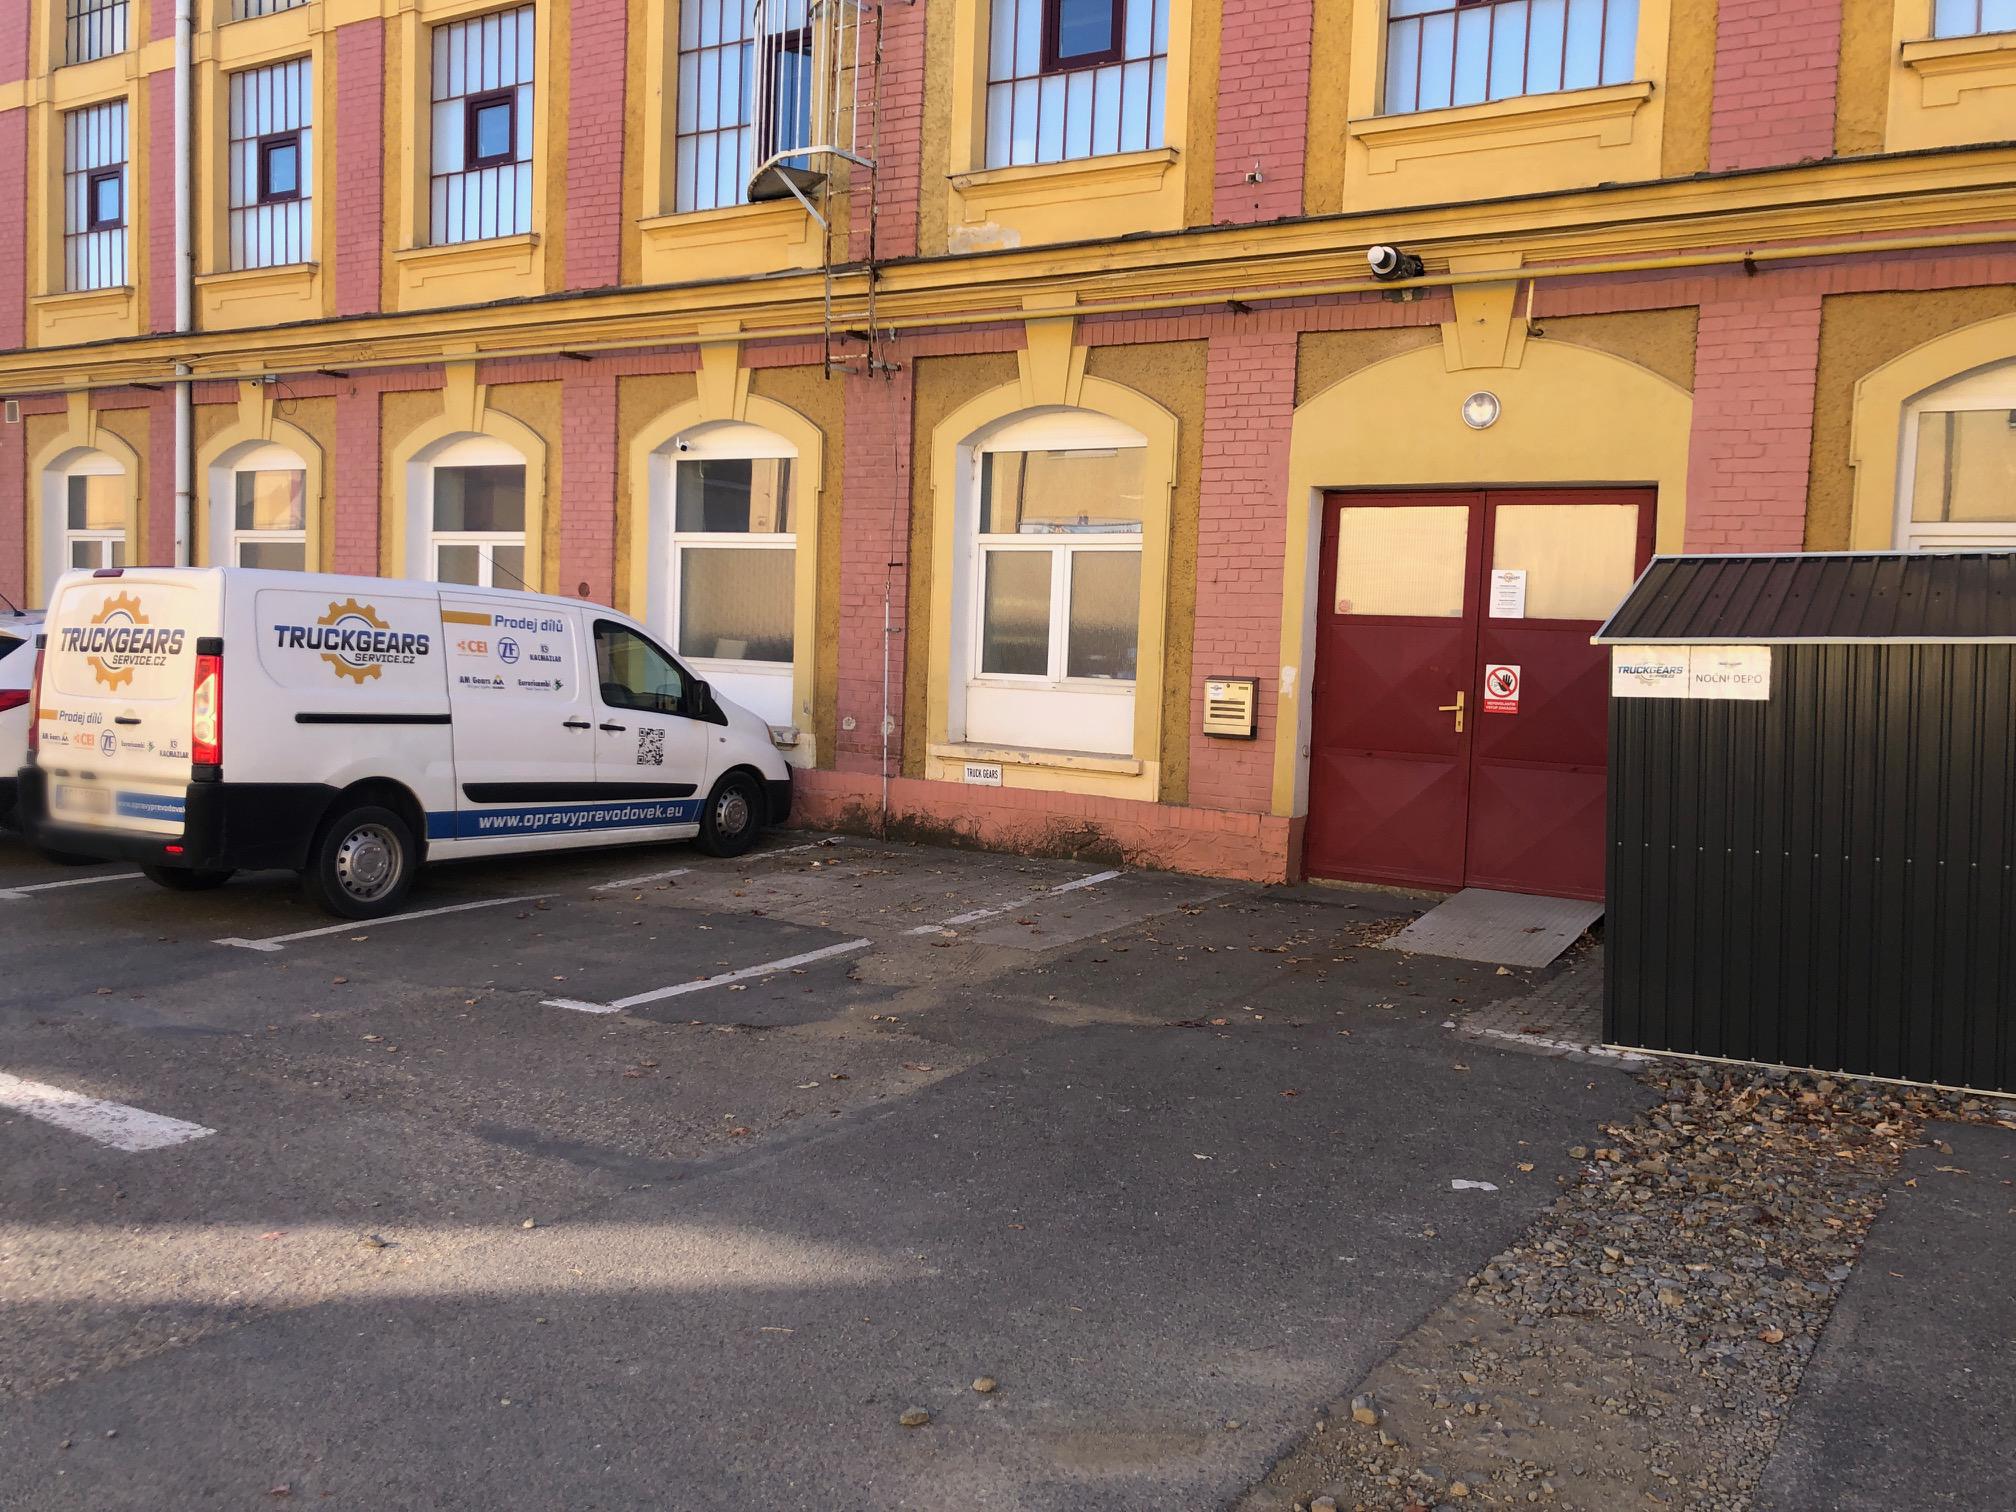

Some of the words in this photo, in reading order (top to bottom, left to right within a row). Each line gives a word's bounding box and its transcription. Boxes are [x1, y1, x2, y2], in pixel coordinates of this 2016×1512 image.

[495, 614, 538, 633] Prodej
[541, 617, 563, 632] dílů
[61, 627, 185, 655] TRUCKGEARS
[274, 624, 430, 655] TRUCKGEARS
[499, 642, 518, 658] ZF
[112, 654, 167, 667] SERVICE.CZ
[354, 653, 416, 664] SERVICE.CZ
[1617, 666, 1684, 675] TRUCKGEARS
[1733, 674, 1763, 684] DEPO
[59, 710, 86, 726] Prodej
[87, 713, 103, 725] dílů
[101, 735, 116, 751] ZF
[966, 767, 982, 778] TRUCK
[982, 769, 999, 779] GEARS
[478, 805, 684, 830] www.opravyprevodovek.eu
